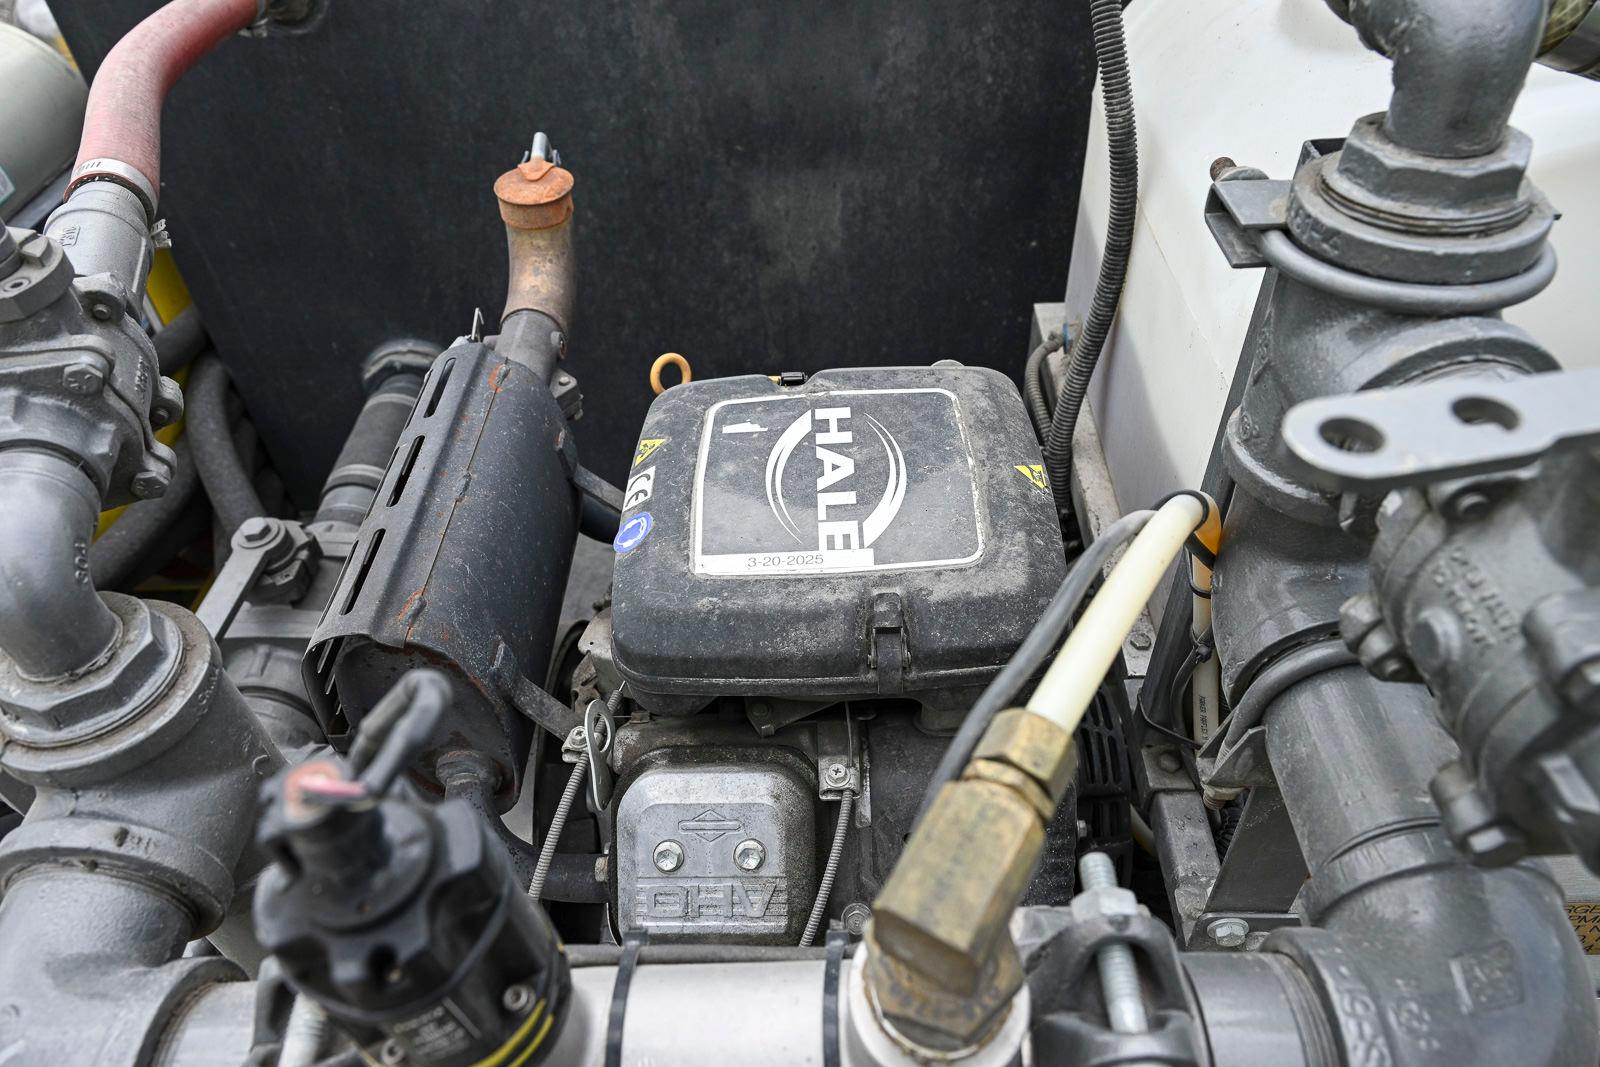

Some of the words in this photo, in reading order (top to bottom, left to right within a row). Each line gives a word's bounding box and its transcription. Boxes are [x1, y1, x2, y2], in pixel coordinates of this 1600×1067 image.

[814, 406, 860, 551] HALE
[747, 554, 824, 567] 3-20-2025
[647, 884, 777, 919] OHV
